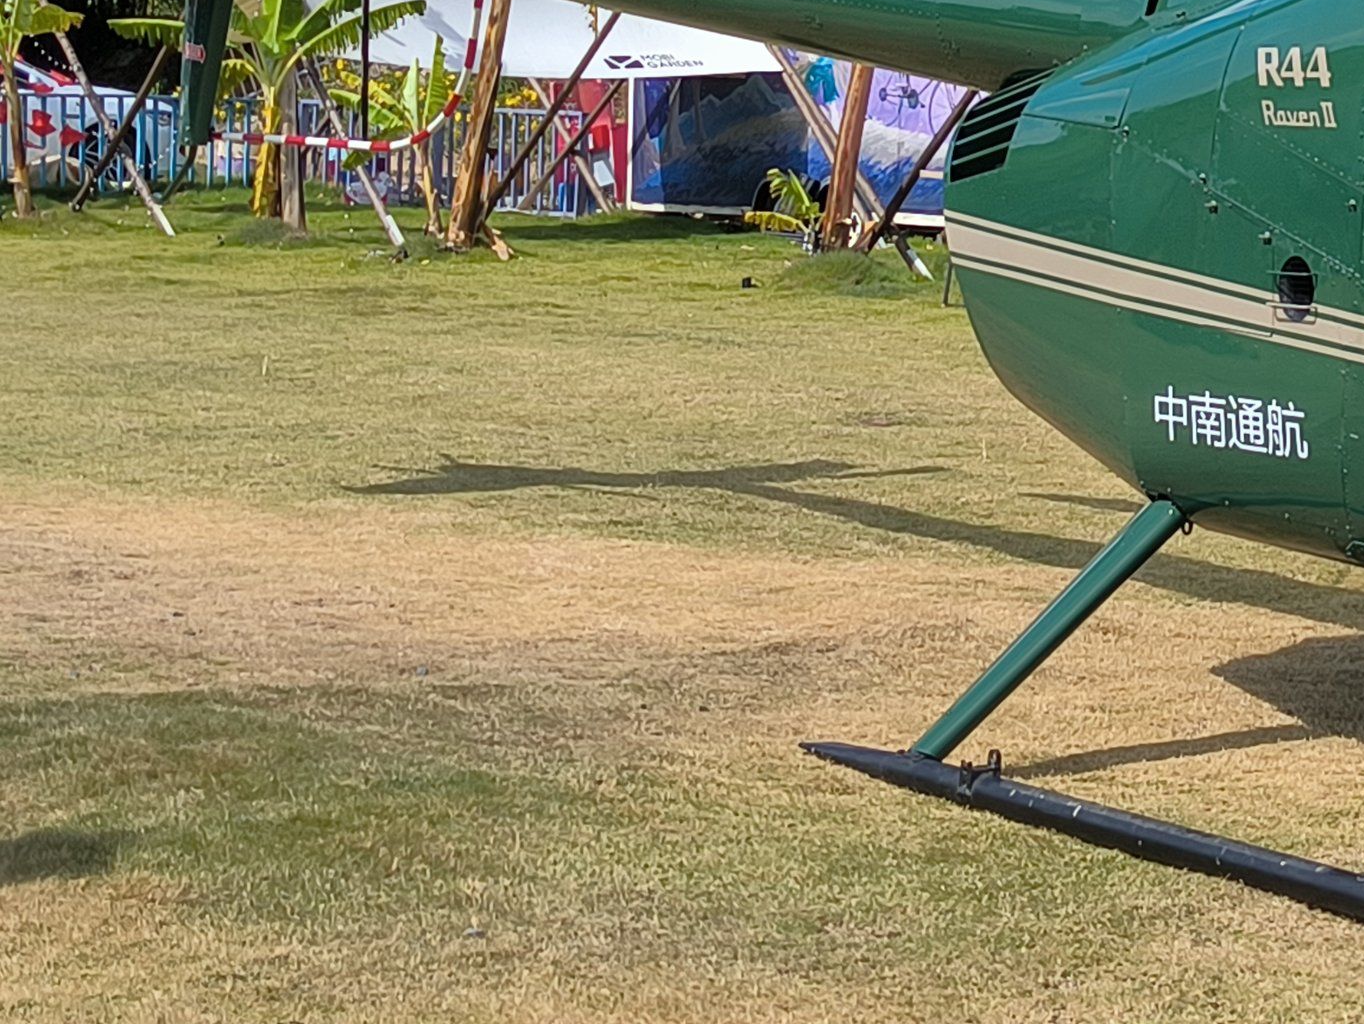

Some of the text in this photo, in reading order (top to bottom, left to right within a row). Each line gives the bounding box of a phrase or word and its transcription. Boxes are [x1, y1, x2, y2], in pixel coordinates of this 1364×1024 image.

[646, 60, 704, 68] GARDEN
[1257, 46, 1331, 88] R44
[1261, 99, 1320, 127] Raven
[1154, 384, 1309, 459] 中南通航
